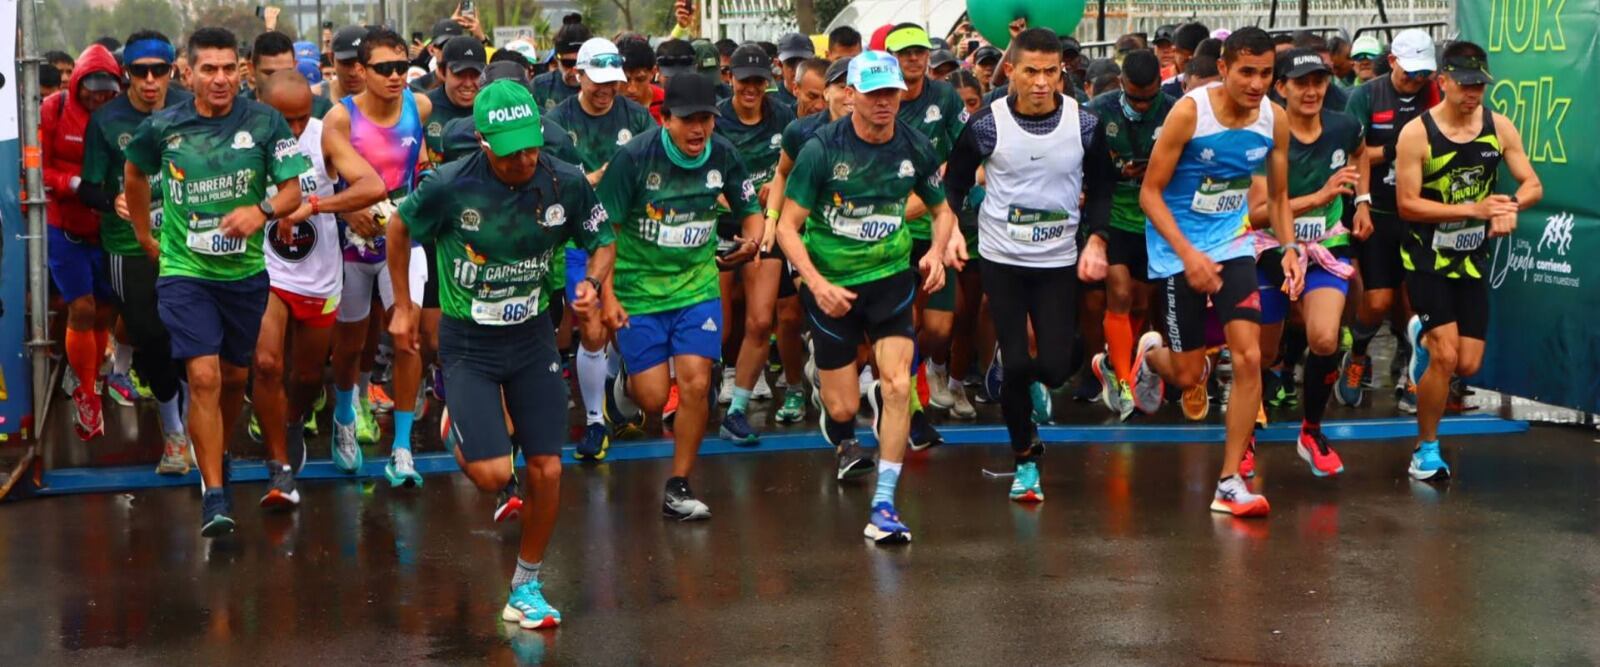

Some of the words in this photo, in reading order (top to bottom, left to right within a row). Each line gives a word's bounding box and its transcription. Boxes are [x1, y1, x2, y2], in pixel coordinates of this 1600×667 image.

[1489, 0, 1567, 53] 10k
[488, 103, 533, 124] POLICIA
[1490, 76, 1572, 163] 21k
[187, 176, 233, 194] CARRERA
[188, 195, 200, 204] POR
[200, 194, 208, 203] LA
[1216, 194, 1243, 211] 9193
[1032, 225, 1064, 242] 8589
[1536, 258, 1572, 274] corriendo
[1533, 273, 1544, 284] por
[1544, 273, 1553, 284] los
